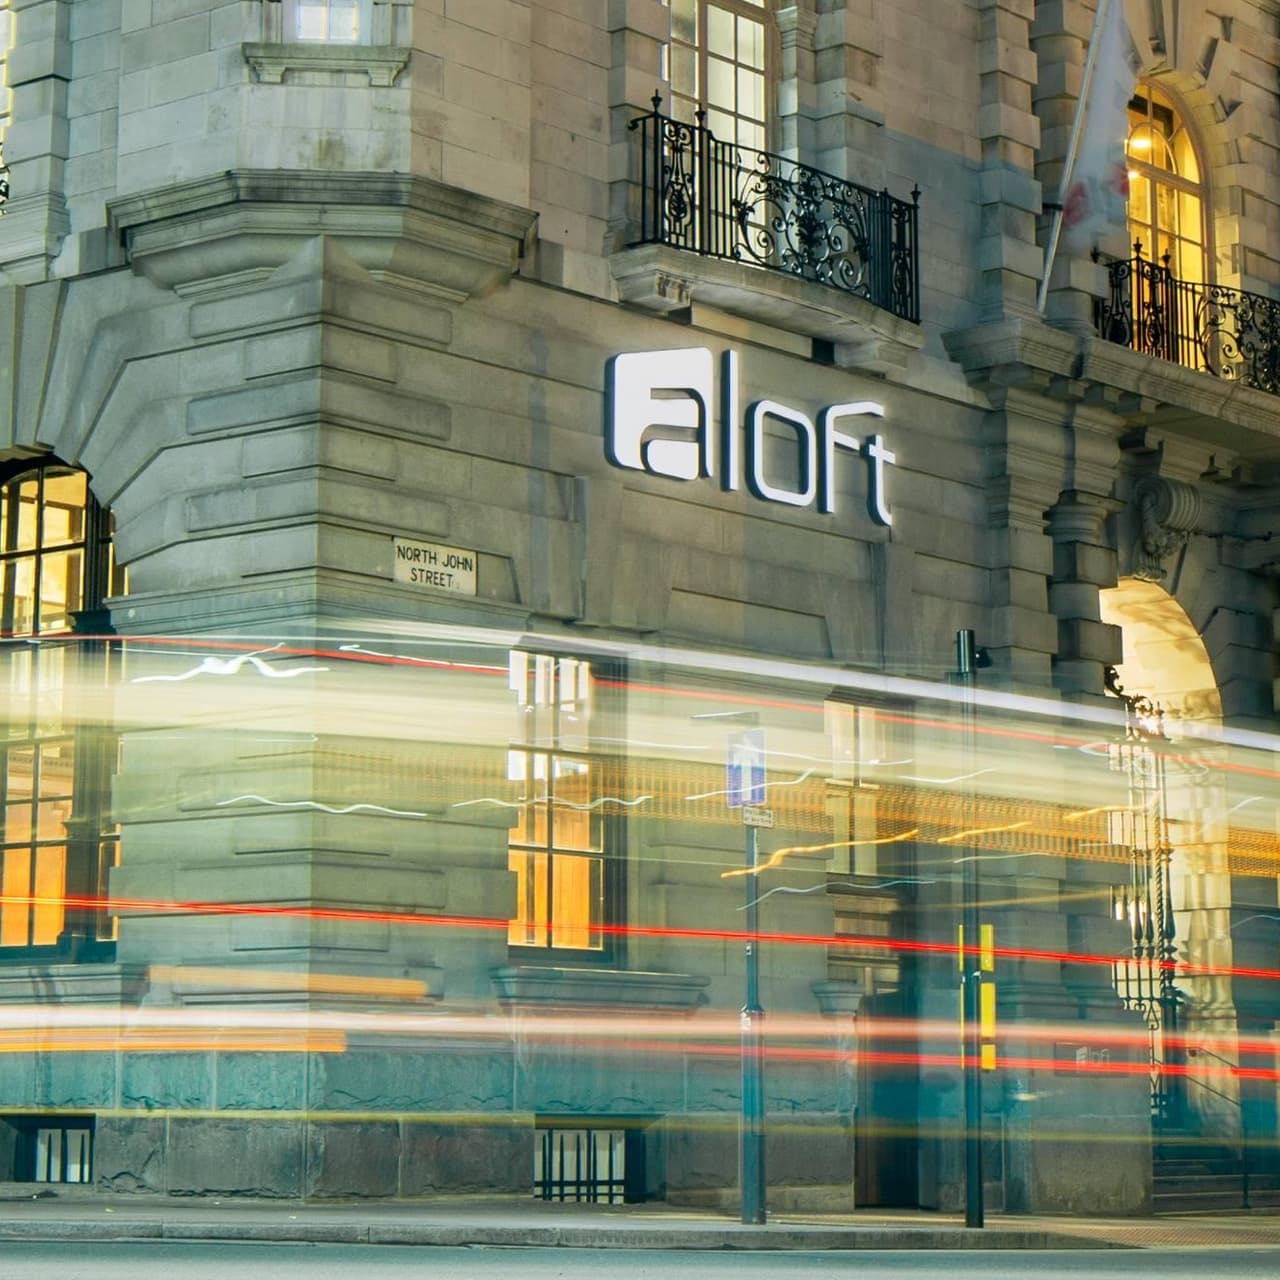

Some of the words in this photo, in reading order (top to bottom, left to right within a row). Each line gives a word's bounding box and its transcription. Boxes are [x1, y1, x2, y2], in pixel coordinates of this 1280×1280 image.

[609, 347, 896, 526] aloft
[397, 545, 437, 565] NORTH
[442, 554, 473, 572] JOHN
[410, 567, 453, 588] STREET
